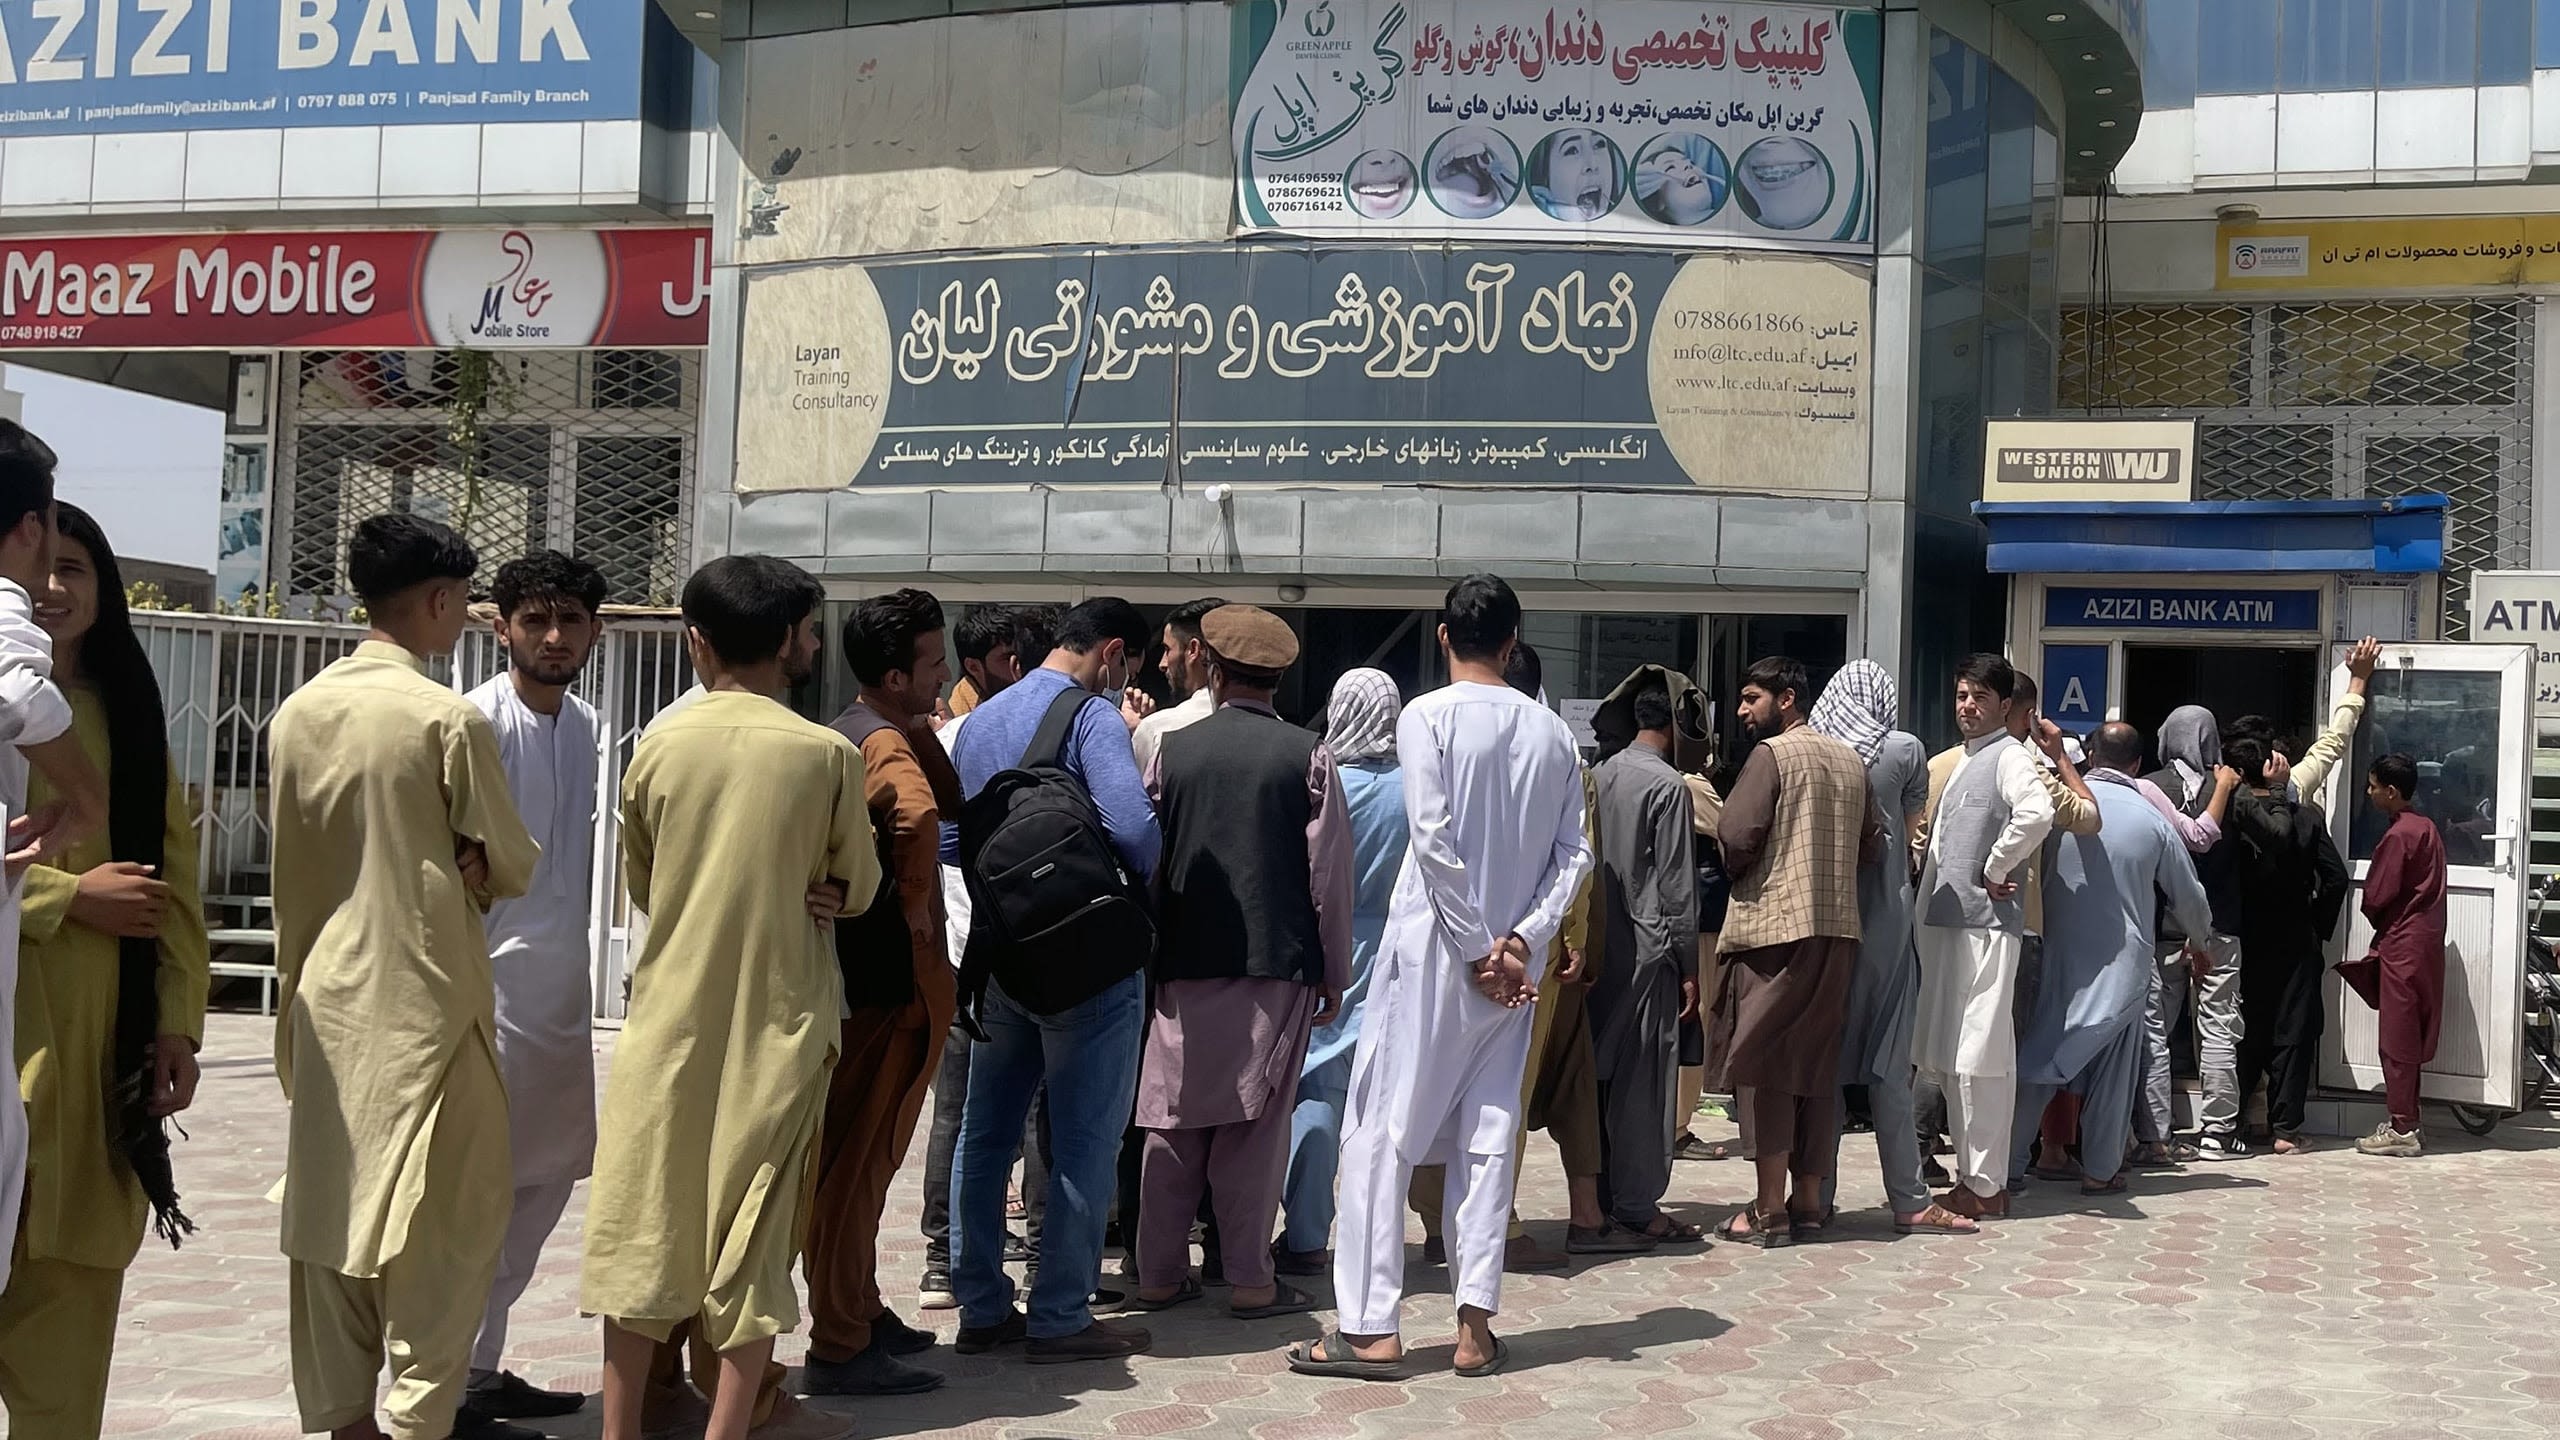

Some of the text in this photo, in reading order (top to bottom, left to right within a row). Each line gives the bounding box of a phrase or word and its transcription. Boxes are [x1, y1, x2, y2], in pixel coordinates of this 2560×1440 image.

[0, 0, 590, 84] ZIZI BANK
[1286, 40, 1352, 51] GREEN APPLE
[1612, 13, 1729, 84] تخصصی
[1734, 16, 1830, 90] کلینیک
[84, 97, 277, 121] panjsadfamily@azizibank.af
[297, 95, 332, 109] 0797
[338, 93, 365, 107] 888
[369, 92, 397, 106] 075
[418, 91, 476, 106] Panjsad
[481, 90, 530, 106] Family
[535, 89, 590, 102] Branch
[1427, 92, 1453, 114] شما
[1457, 94, 1489, 120] های
[1493, 94, 1539, 121] دندان
[1595, 104, 1605, 123] و
[1715, 100, 1753, 127] مکان
[1786, 107, 1824, 132] گرین
[1268, 173, 1343, 183] 0764696597
[1268, 187, 1343, 198] 0786769621
[1268, 201, 1343, 212] 0706716142
[2322, 247, 2338, 263] ان
[2365, 247, 2379, 261] ام
[2385, 246, 2457, 261] محصولات
[2464, 240, 2522, 260] فروشات
[3, 245, 375, 317] Maaz Mobile
[1, 325, 83, 340] 0748 918 427
[516, 324, 549, 337] Store
[899, 275, 1001, 384] لیان
[1674, 310, 1859, 339] تماس: 0788661866
[1218, 304, 1259, 379] و
[796, 345, 840, 366] Layan
[1674, 343, 1808, 365] info@ltc.edu.af
[794, 368, 850, 388] Training
[1676, 375, 1790, 392] www.ltc.edu.af
[793, 391, 878, 412] Consultancy
[879, 441, 938, 470] مسلکی
[942, 440, 973, 467] های
[1046, 437, 1107, 466] کانکور
[1111, 433, 1170, 466] آمادگی
[1265, 437, 1310, 467] علوم
[2004, 452, 2169, 480] WESTERN WU
[2033, 466, 2099, 479] UNION
[2083, 598, 2274, 622] AZIZI BANK ATM
[2058, 676, 2089, 712] A
